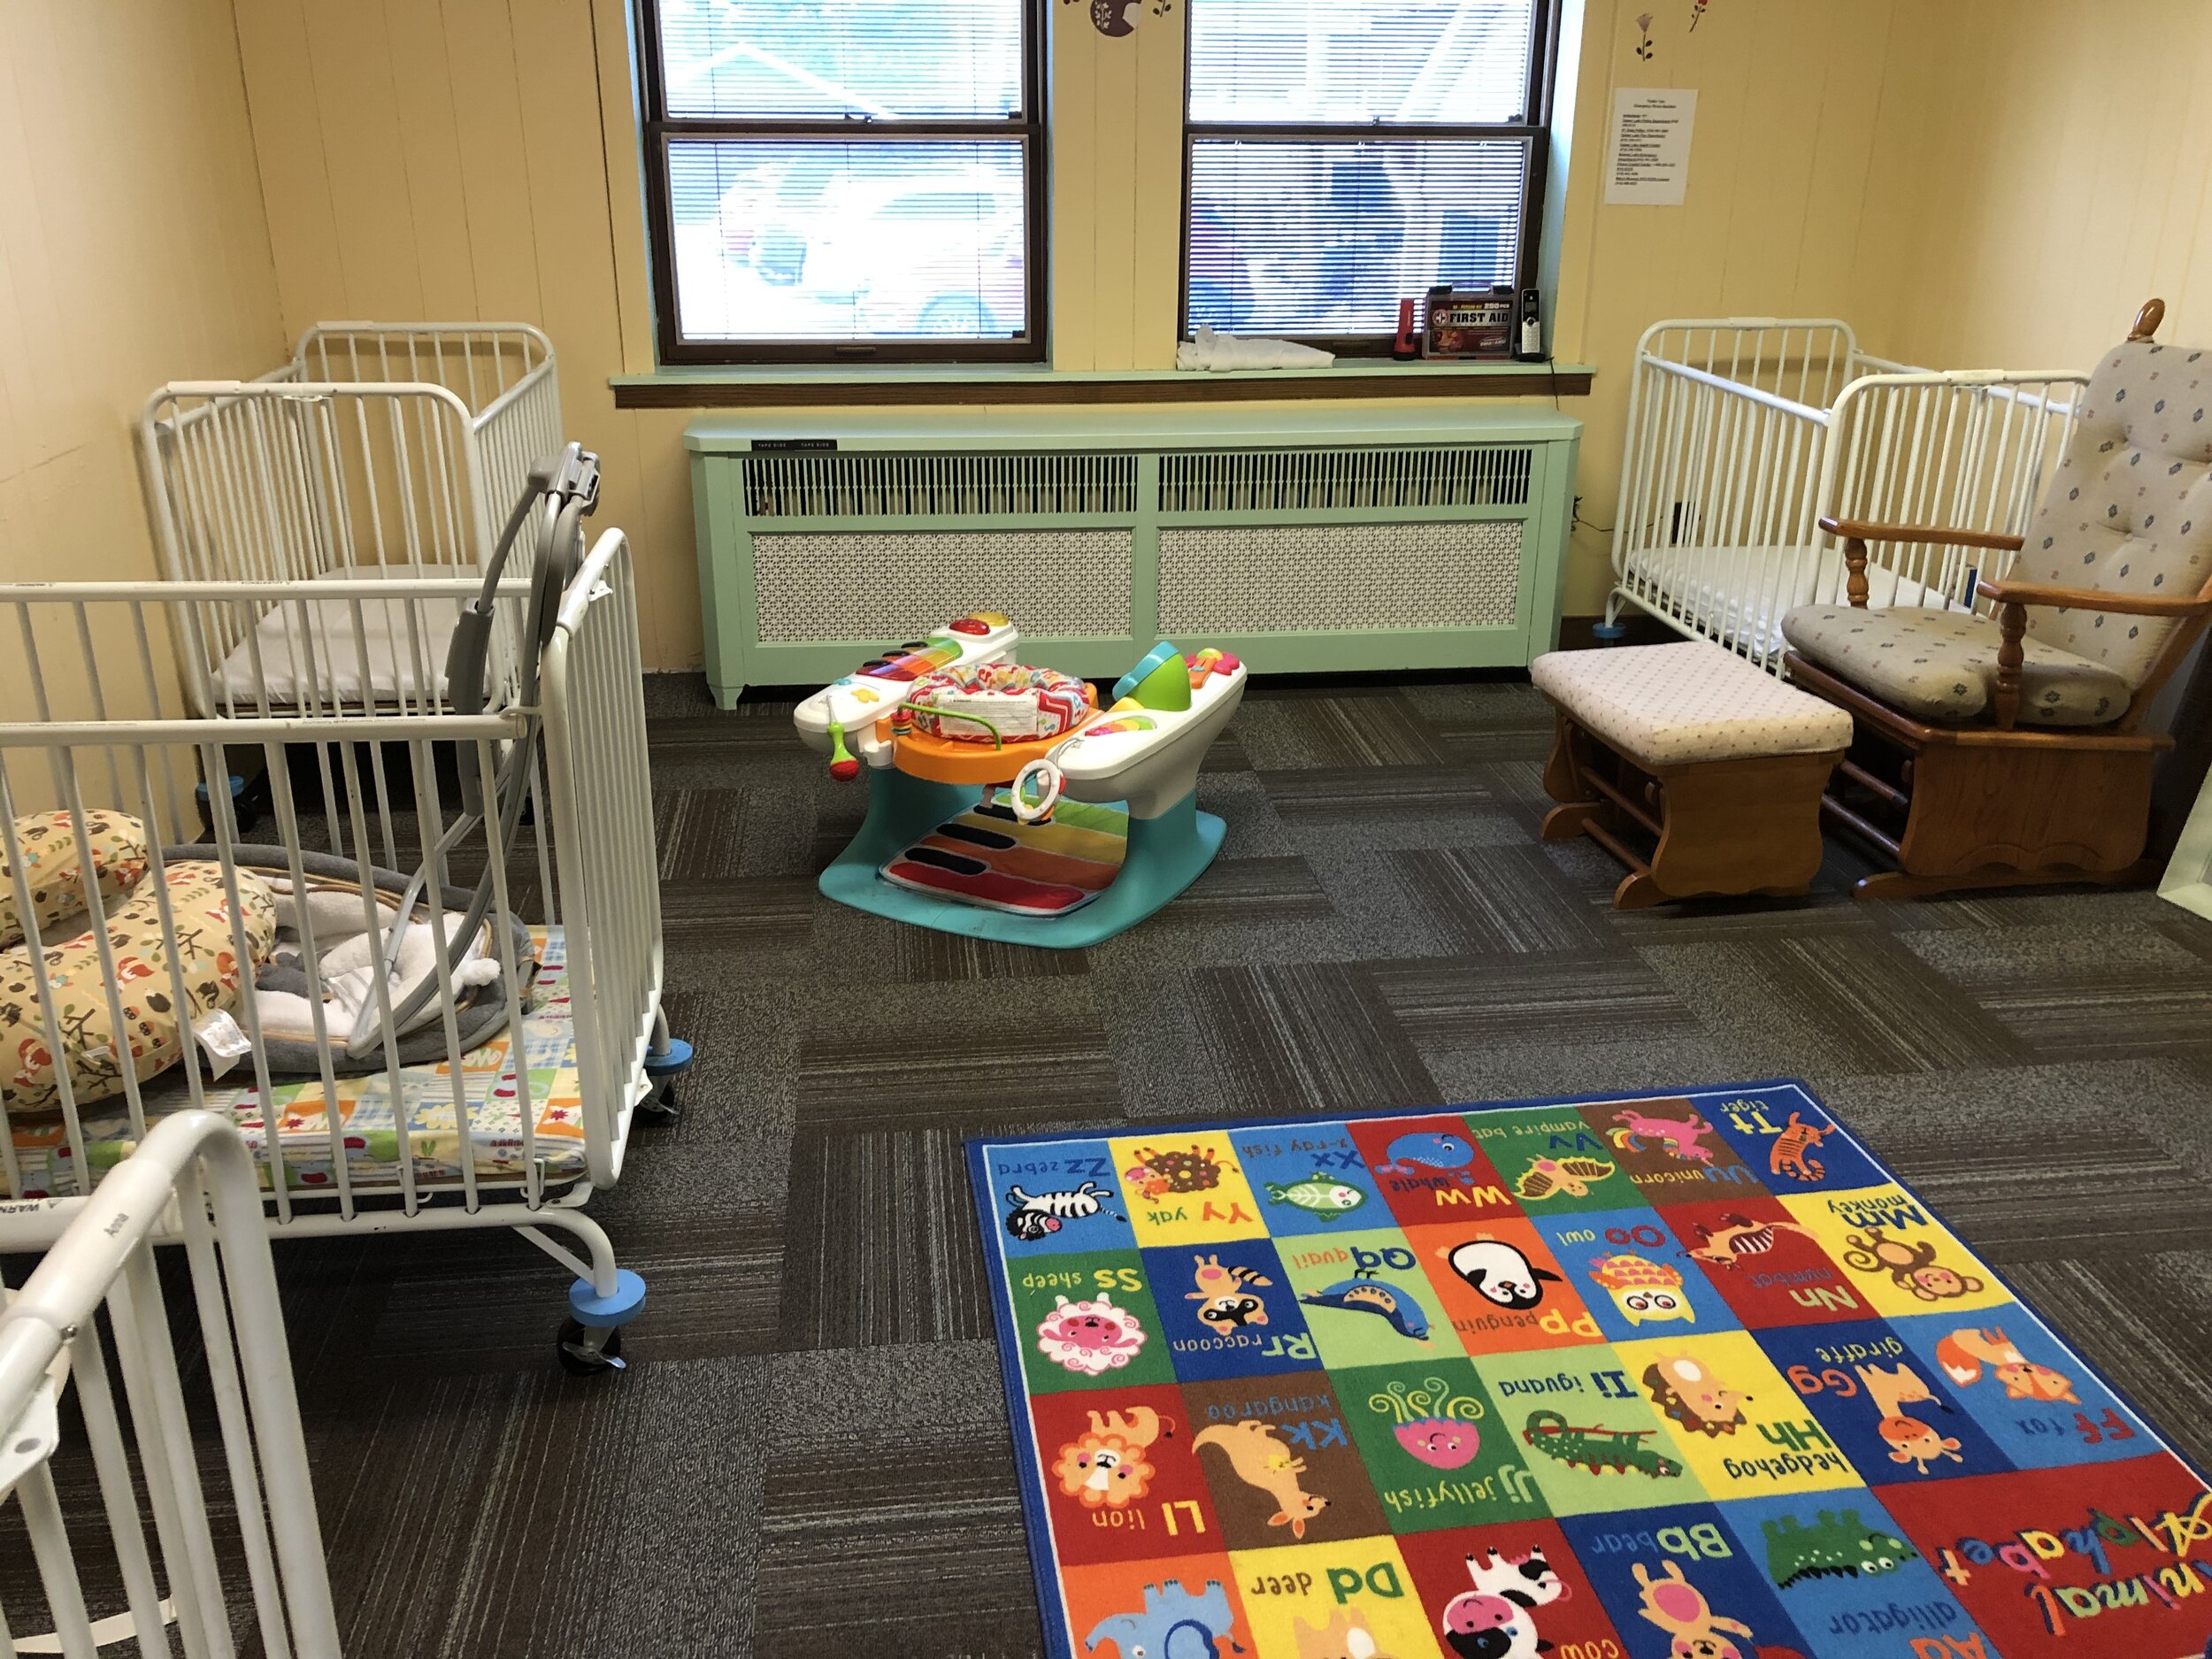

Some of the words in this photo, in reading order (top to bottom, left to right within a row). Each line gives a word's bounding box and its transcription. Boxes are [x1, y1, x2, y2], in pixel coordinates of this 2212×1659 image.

[1450, 312, 1486, 323] FIRST
[1489, 312, 1509, 323] AID
[1720, 1099, 1770, 1114] tiger
[1471, 1126, 1506, 1140] bat
[1512, 1120, 1591, 1136] vampire
[1732, 1111, 1782, 1135] Tt
[1242, 1139, 1282, 1156] fish
[1291, 1137, 1348, 1152] x-ray
[998, 1161, 1058, 1176] zebra
[1064, 1157, 1111, 1178] Zz
[1310, 1150, 1367, 1171] Xx
[1389, 1177, 1451, 1192] whale
[1629, 1167, 1705, 1186] unicorn
[1702, 1164, 1758, 1186] Uu
[1436, 1185, 1513, 1208] Ww
[1827, 1194, 1905, 1214] monkey
[1148, 1206, 1188, 1225] yak
[1841, 1203, 1930, 1231] Mm
[1556, 1228, 1596, 1247] owl
[1292, 1247, 1349, 1271] quail
[1349, 1246, 1417, 1271] Qq
[1022, 1271, 1082, 1289] sheep
[1746, 1266, 1834, 1288] numbat
[1788, 1284, 1860, 1312] Nn
[1450, 1310, 1540, 1335] penguin
[1539, 1308, 1602, 1337] Pp
[1172, 1336, 1263, 1352] raccoon
[1262, 1332, 1317, 1360] Rr
[1815, 1335, 1904, 1363] giraffe
[1498, 1371, 1584, 1397] iguana
[1590, 1370, 1640, 1399] Ii
[1786, 1364, 1857, 1397] Gg
[1207, 1394, 1333, 1419] kangaroo
[1282, 1417, 1348, 1450] Kk
[1755, 1418, 1833, 1452] Hh
[2014, 1416, 2066, 1437] fox
[2074, 1407, 2137, 1445] Ff
[1723, 1451, 1849, 1480] hedgehog
[1384, 1473, 1494, 1514] jellyfish
[1497, 1463, 1535, 1504] Jj
[1092, 1508, 1146, 1530] lion
[1592, 1530, 1657, 1555] bear
[1655, 1522, 1733, 1562] Bb
[1936, 1491, 2212, 1586] Alphabet
[1250, 1571, 1313, 1596] deer
[1325, 1561, 1405, 1605] Dd
[1828, 1600, 1958, 1636] alligator
[1559, 1638, 1620, 1659] cow
